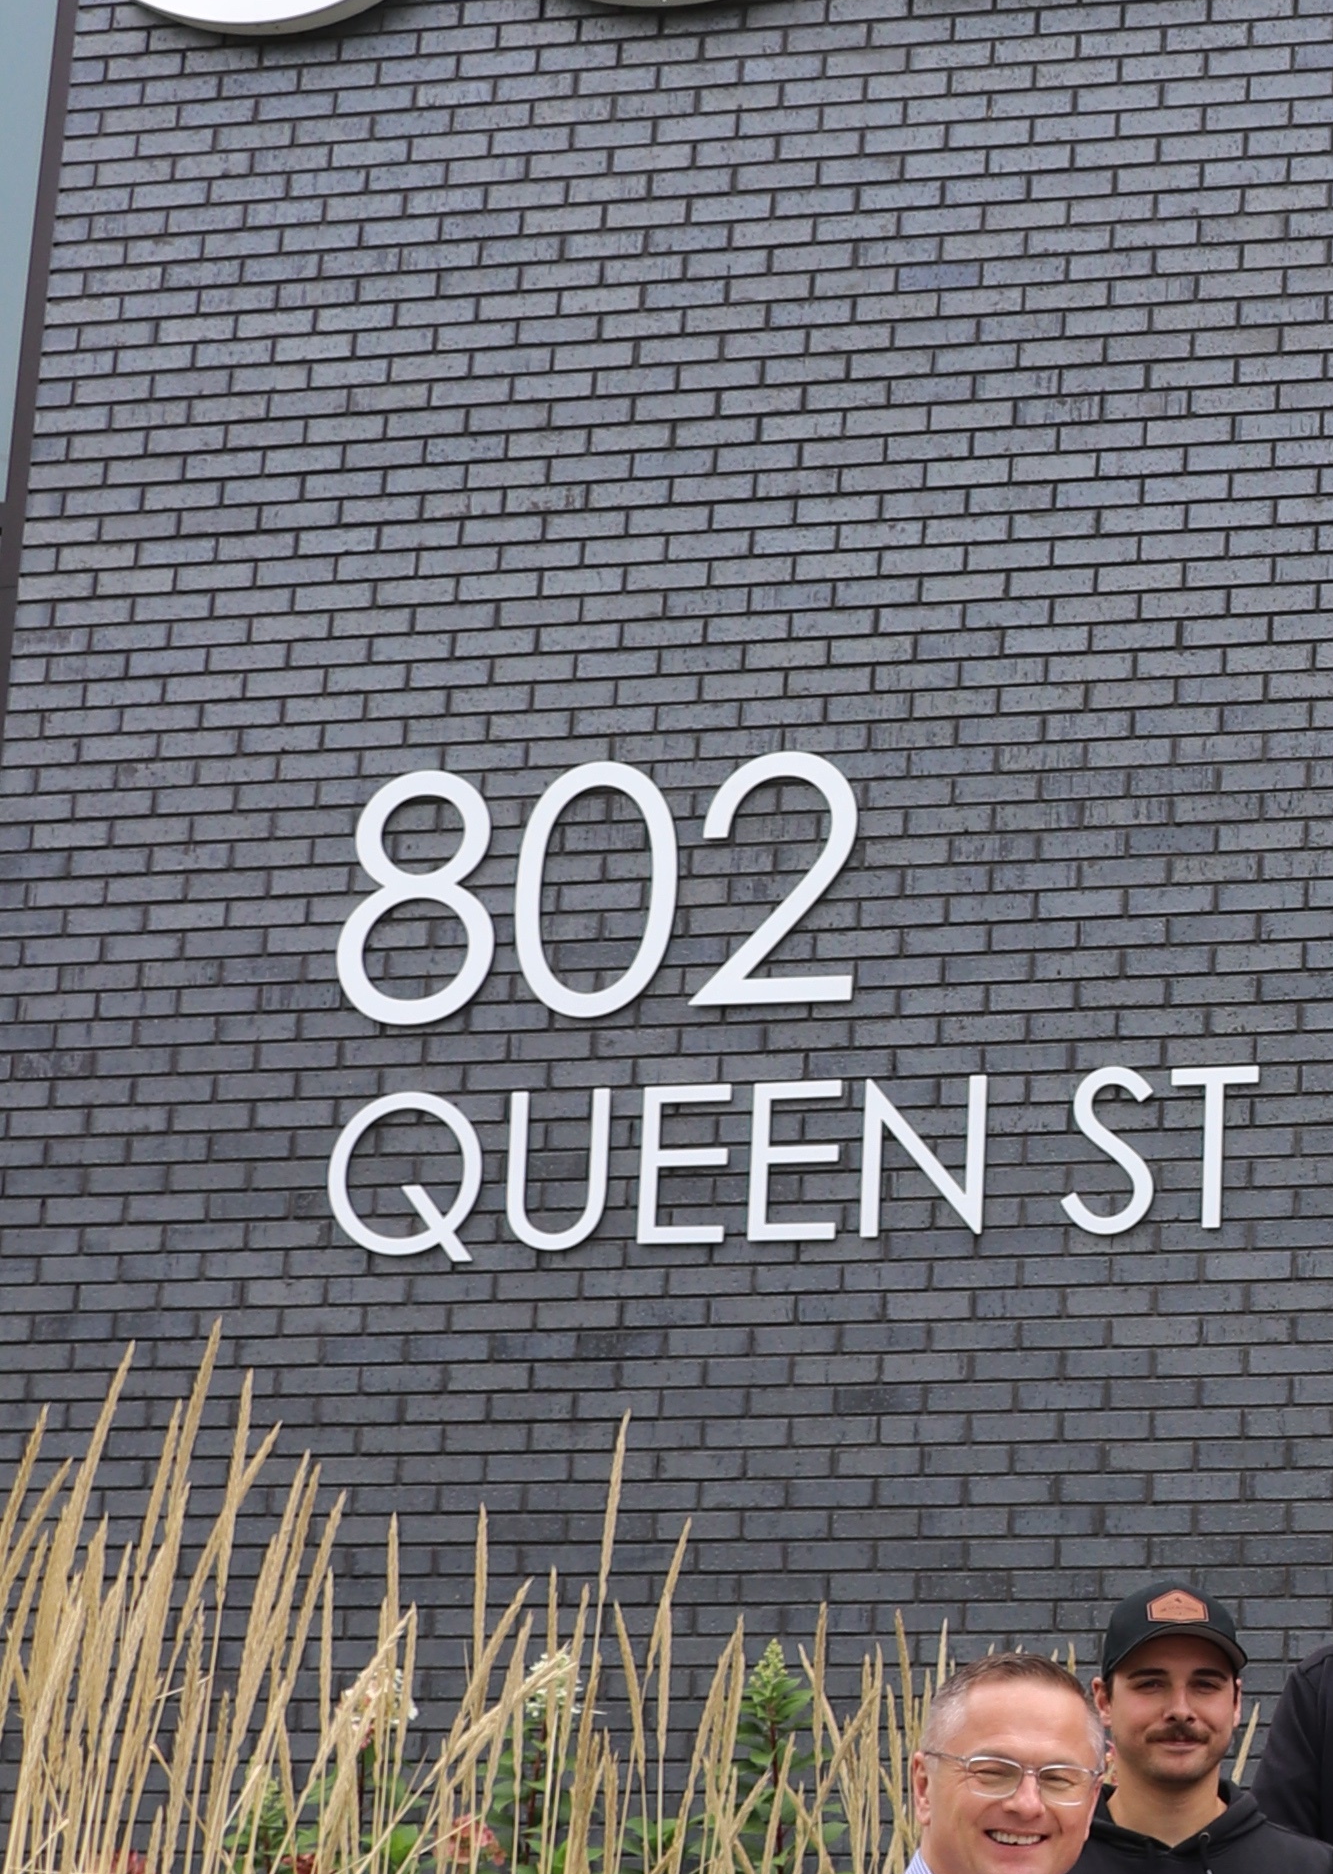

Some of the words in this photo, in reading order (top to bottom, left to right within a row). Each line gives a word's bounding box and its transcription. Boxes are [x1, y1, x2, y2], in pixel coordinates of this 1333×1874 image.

[335, 750, 860, 1026] 802
[327, 1074, 988, 1263] QUEEN
[1060, 1065, 1260, 1236] ST
